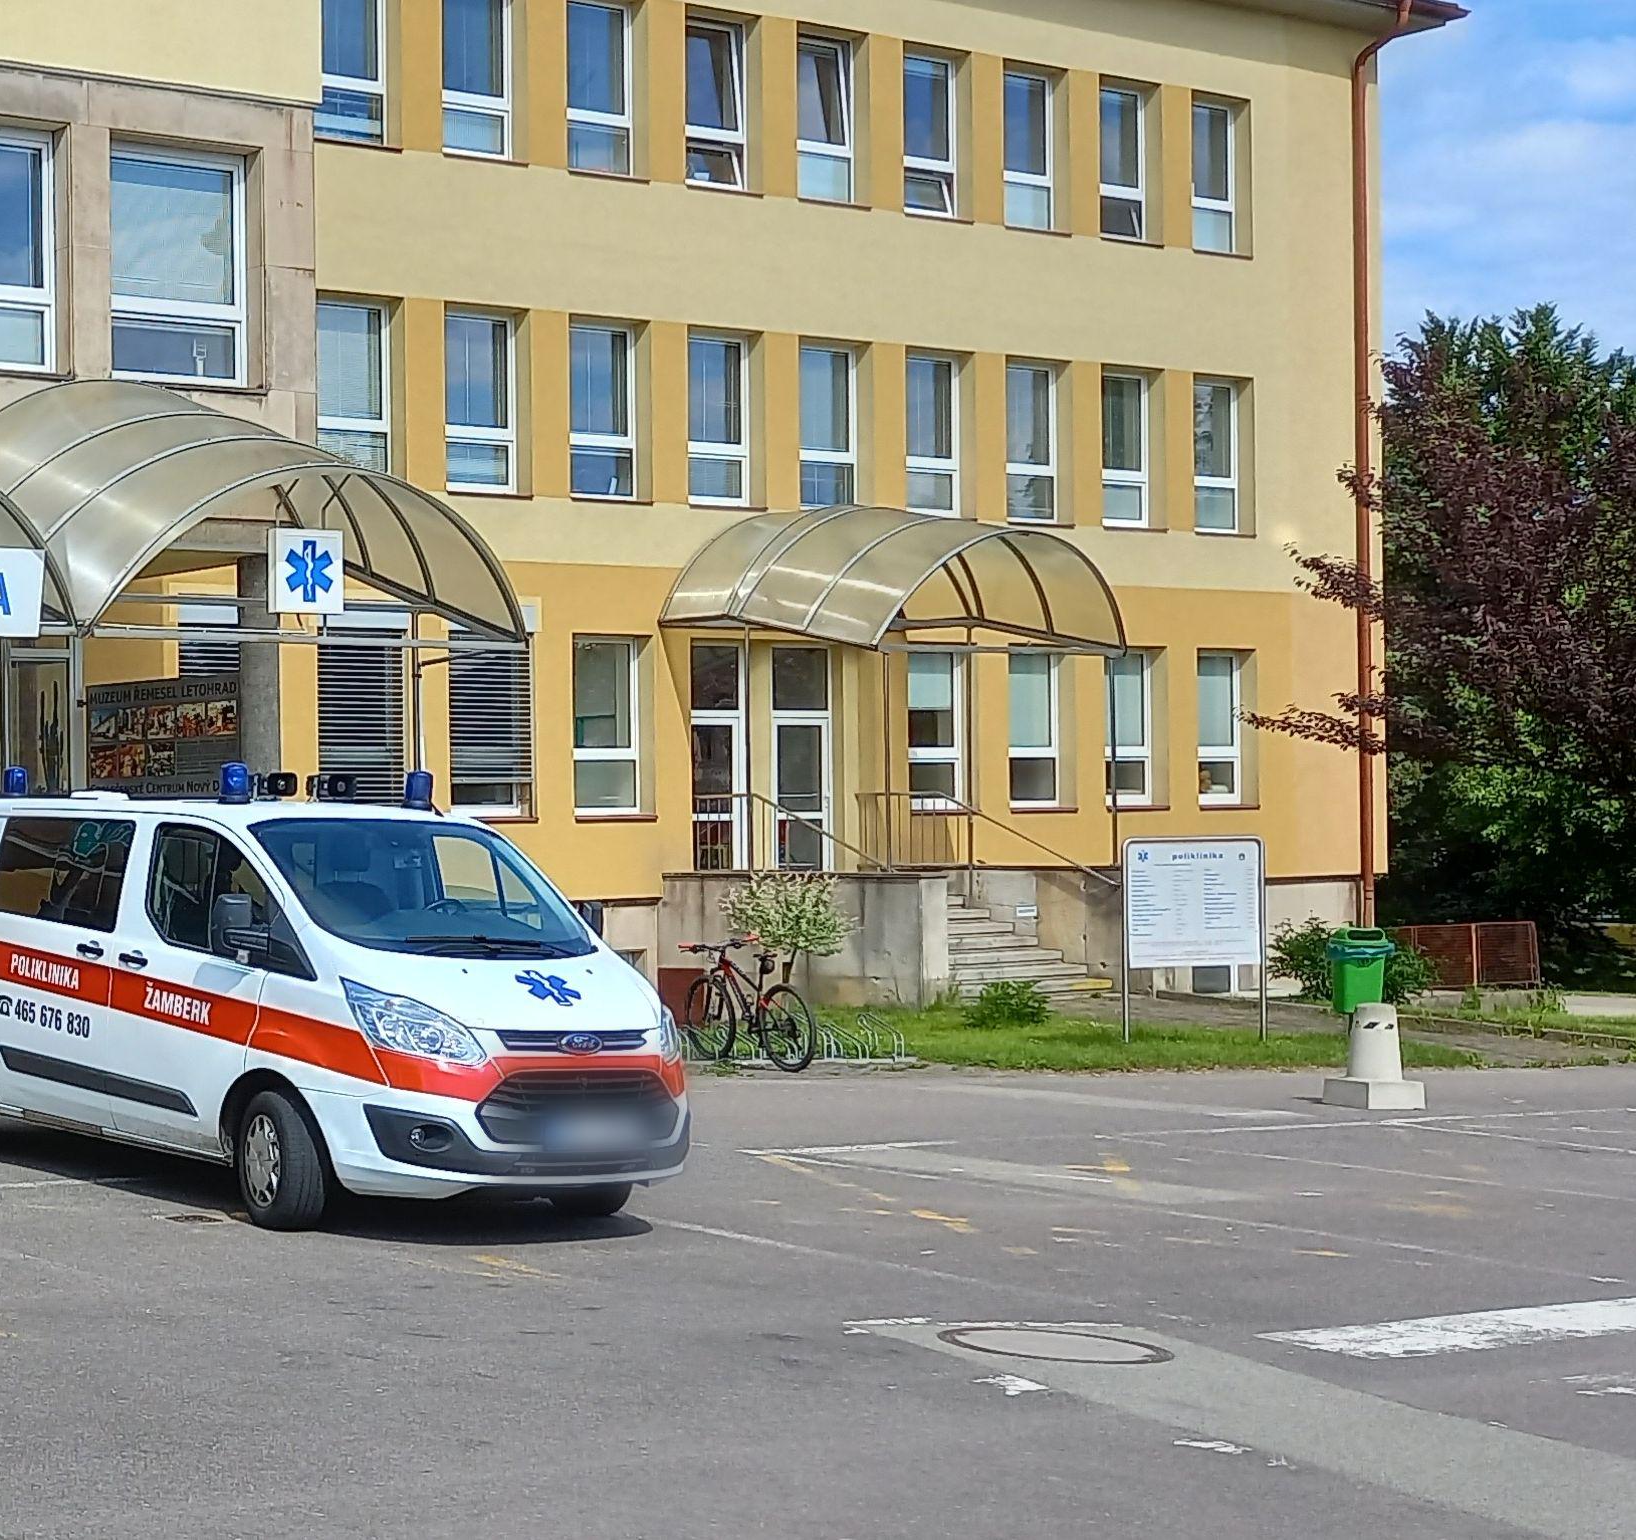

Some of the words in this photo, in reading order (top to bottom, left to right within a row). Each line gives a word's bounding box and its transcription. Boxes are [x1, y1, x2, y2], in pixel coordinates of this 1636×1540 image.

[90, 689, 131, 705] MUZEUM
[133, 686, 178, 701] ŘEMESEL
[181, 681, 237, 697] LETOHRAD
[146, 782, 186, 794] CENTRUM
[187, 779, 211, 793] NOVÝ
[1172, 852, 1224, 861] poliklinika
[10, 953, 80, 990] POLIKLINIKA
[143, 981, 212, 1026] ŽAMBERK
[14, 998, 36, 1024] 465
[40, 1006, 62, 1031] 676
[67, 1012, 91, 1038] 830
